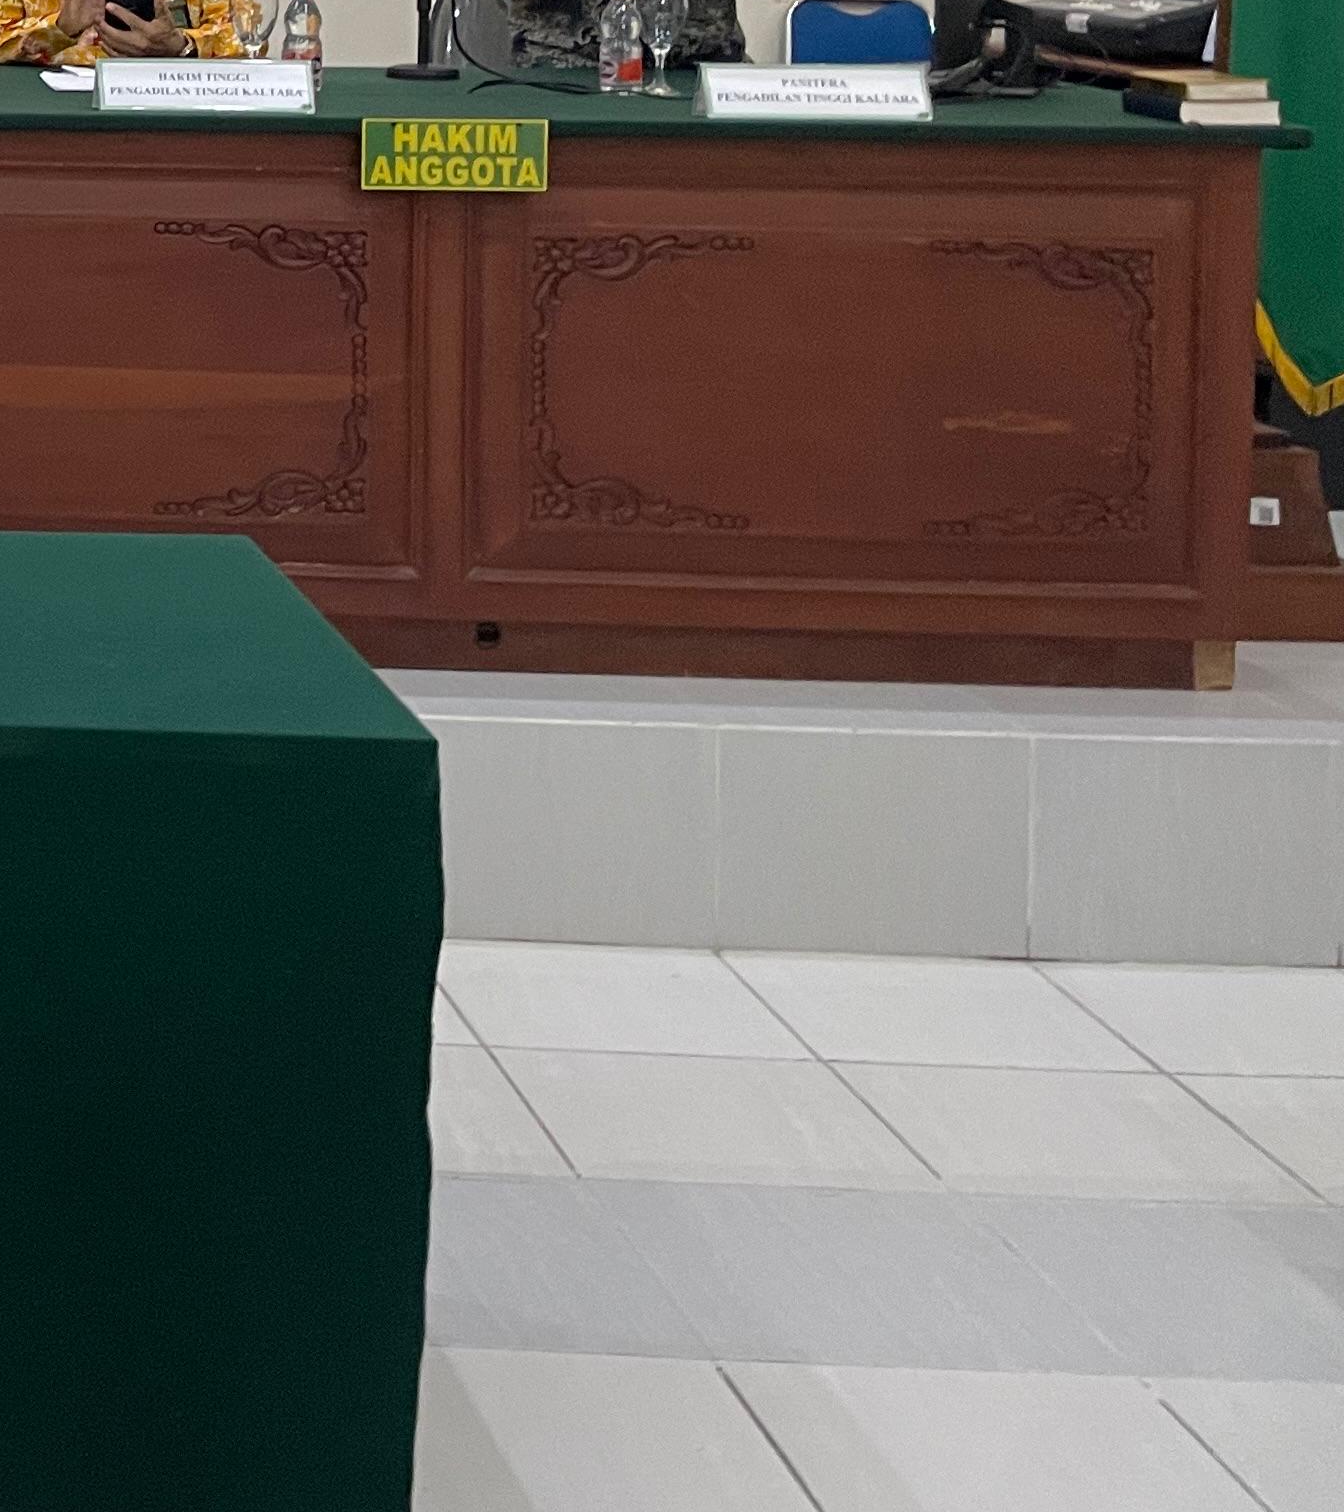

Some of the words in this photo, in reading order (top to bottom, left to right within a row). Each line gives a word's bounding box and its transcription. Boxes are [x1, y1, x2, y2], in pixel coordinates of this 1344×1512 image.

[158, 72, 202, 82] HAKIM
[206, 72, 250, 82] TINGGI
[109, 86, 190, 96] PENGADILAN
[195, 87, 239, 96] TINGGI
[717, 92, 802, 103] PENGADILAN
[806, 93, 852, 104] TINGGI
[855, 94, 920, 105] KALTARA
[393, 123, 518, 155] HAKIM
[370, 155, 541, 187] ANGGOTA
